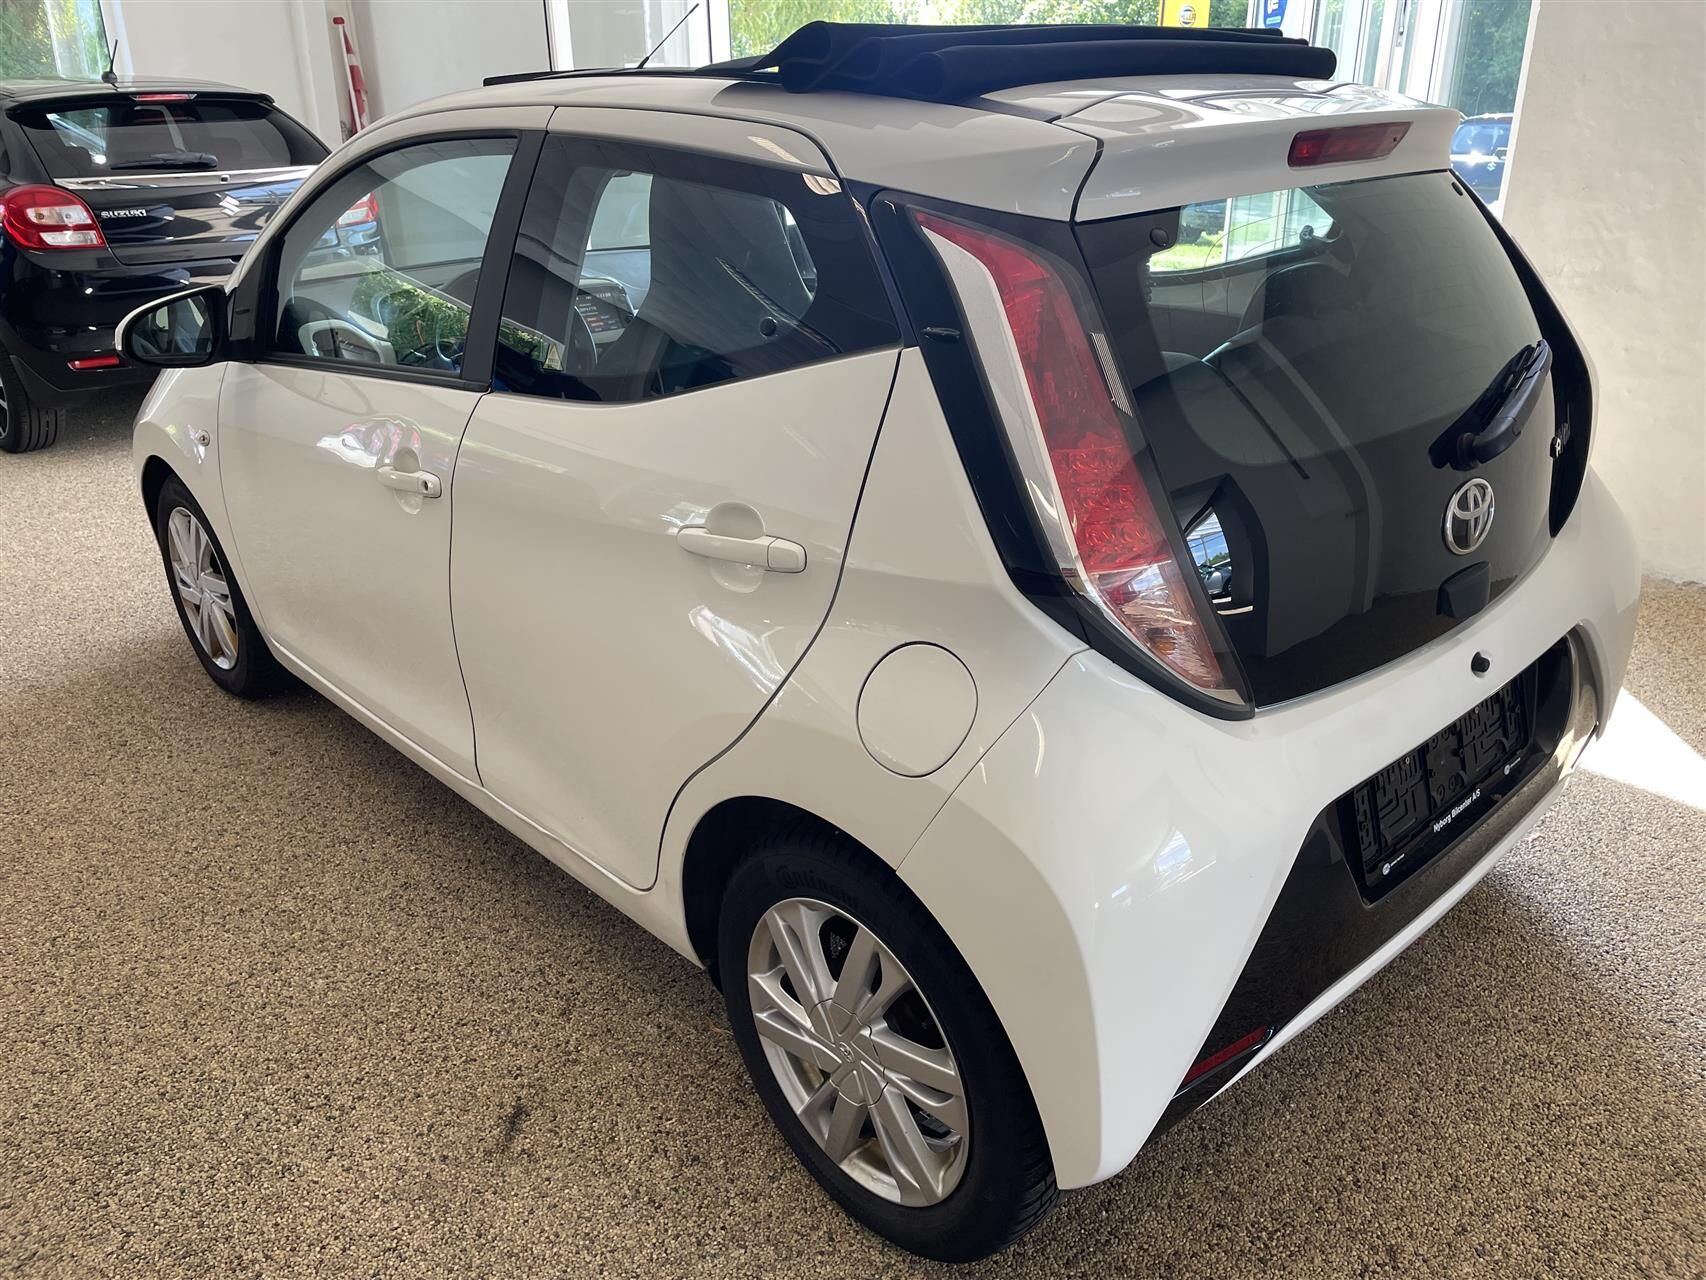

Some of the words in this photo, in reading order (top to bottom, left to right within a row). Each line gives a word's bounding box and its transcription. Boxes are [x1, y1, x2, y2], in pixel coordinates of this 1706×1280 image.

[100, 209, 147, 218] SUZUKI
[1433, 814, 1452, 833] Nyborg
[1451, 797, 1472, 818] Bilcenter
